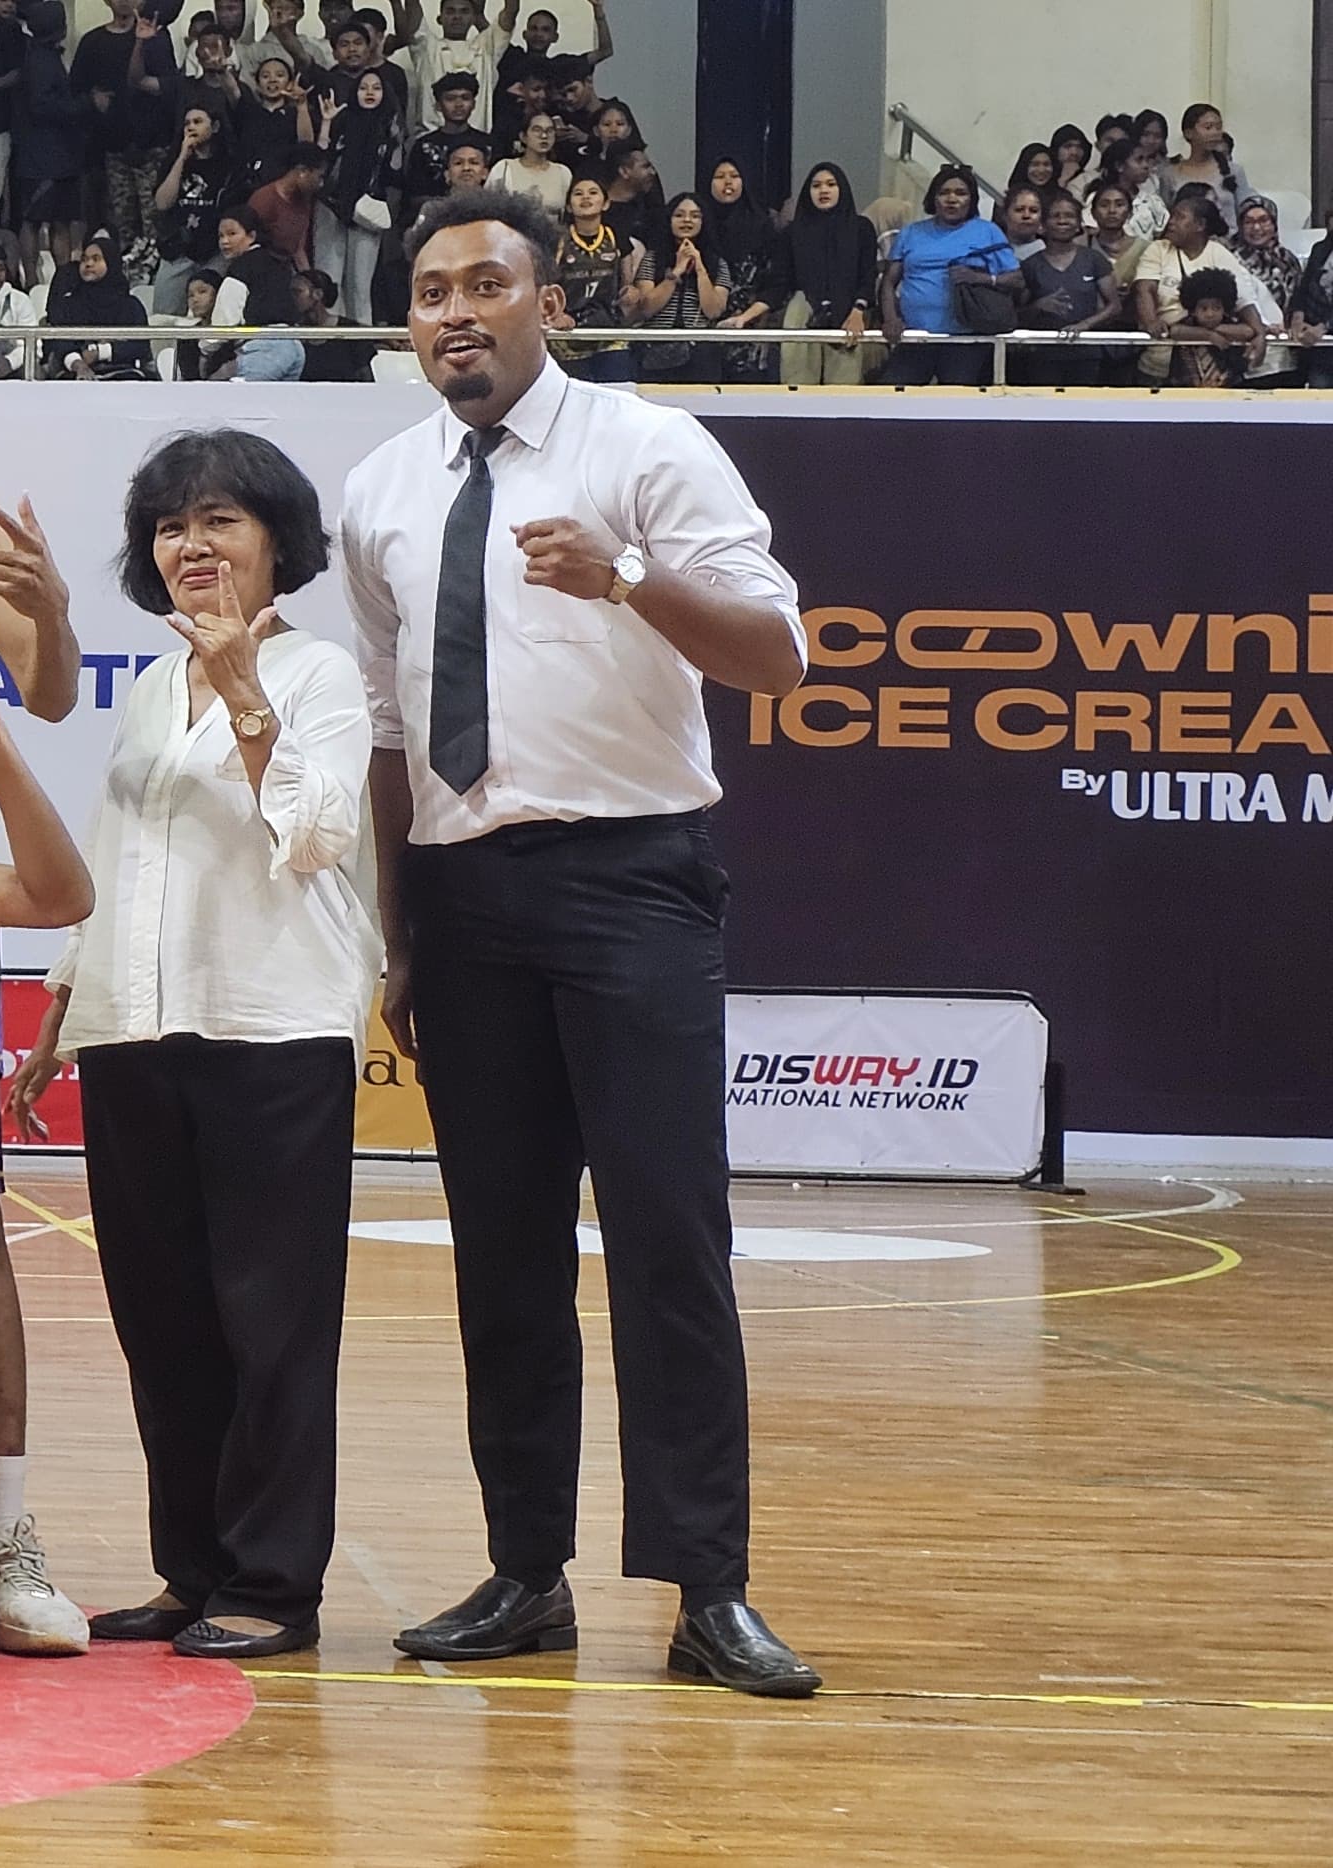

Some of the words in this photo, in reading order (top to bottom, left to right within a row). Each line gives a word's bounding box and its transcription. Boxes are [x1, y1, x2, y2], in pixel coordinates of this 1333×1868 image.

[750, 684, 951, 748] ICE
[1061, 768, 1105, 796] By
[1111, 770, 1287, 822] ULTRA
[733, 1053, 979, 1089] DISWAY.ID
[725, 1088, 841, 1108] NATIONAL
[849, 1090, 969, 1111] NETWORK
